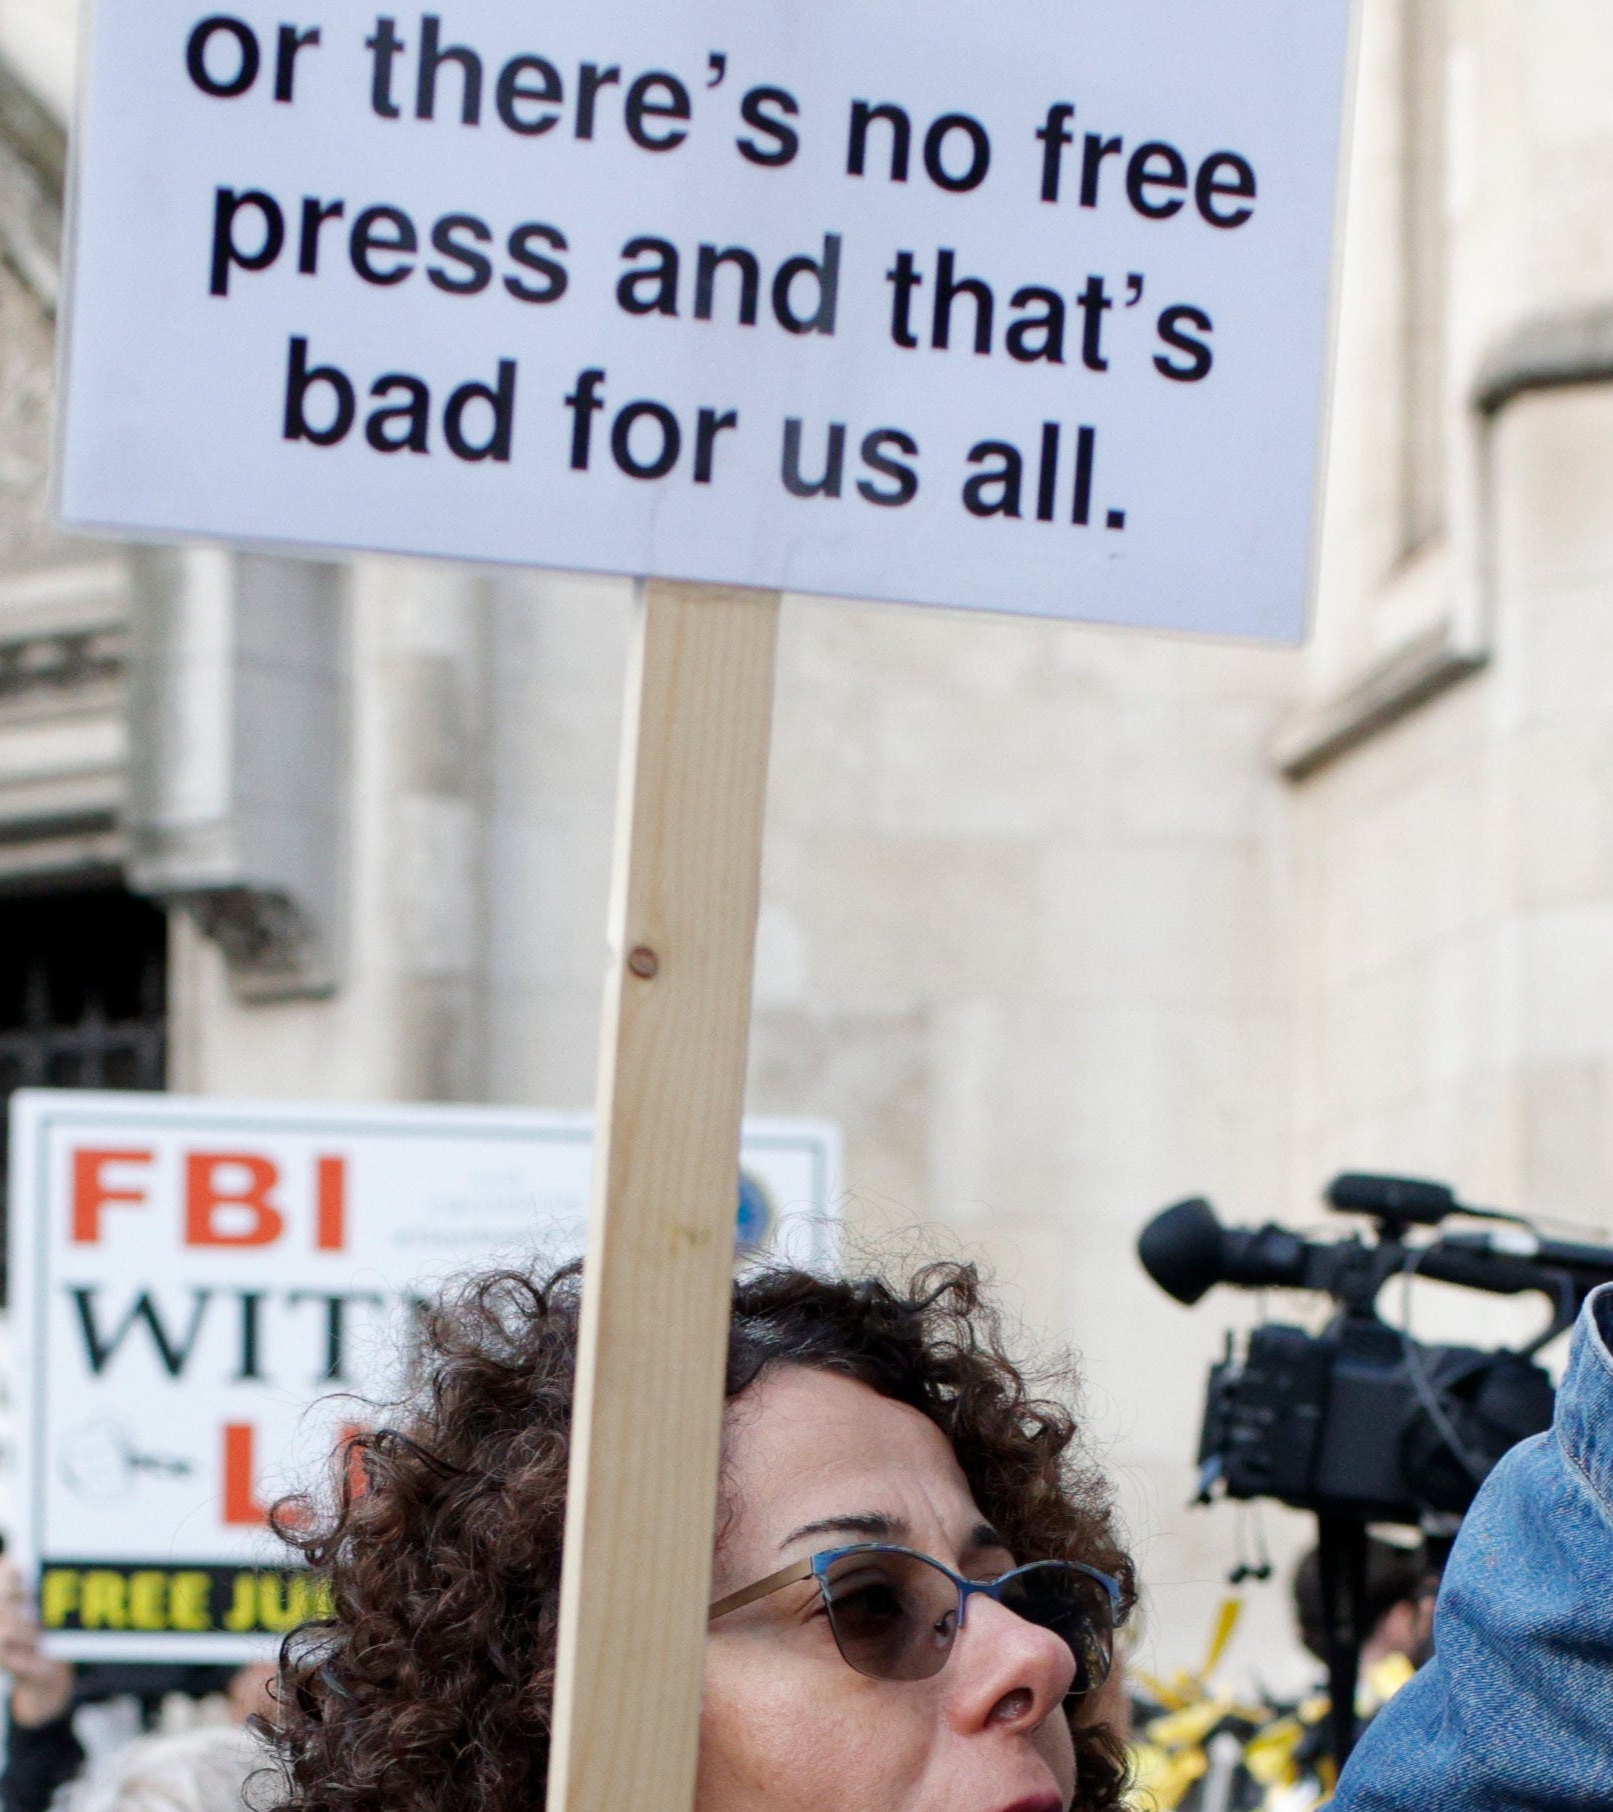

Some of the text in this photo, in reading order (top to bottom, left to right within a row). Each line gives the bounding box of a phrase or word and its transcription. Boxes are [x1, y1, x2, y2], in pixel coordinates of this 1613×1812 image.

[183, 13, 1258, 231] or there's no free
[207, 185, 1215, 384] press and that's
[281, 334, 1127, 532] bad for us all.
[69, 1146, 348, 1253] FBI
[40, 1567, 213, 1632] FREE
